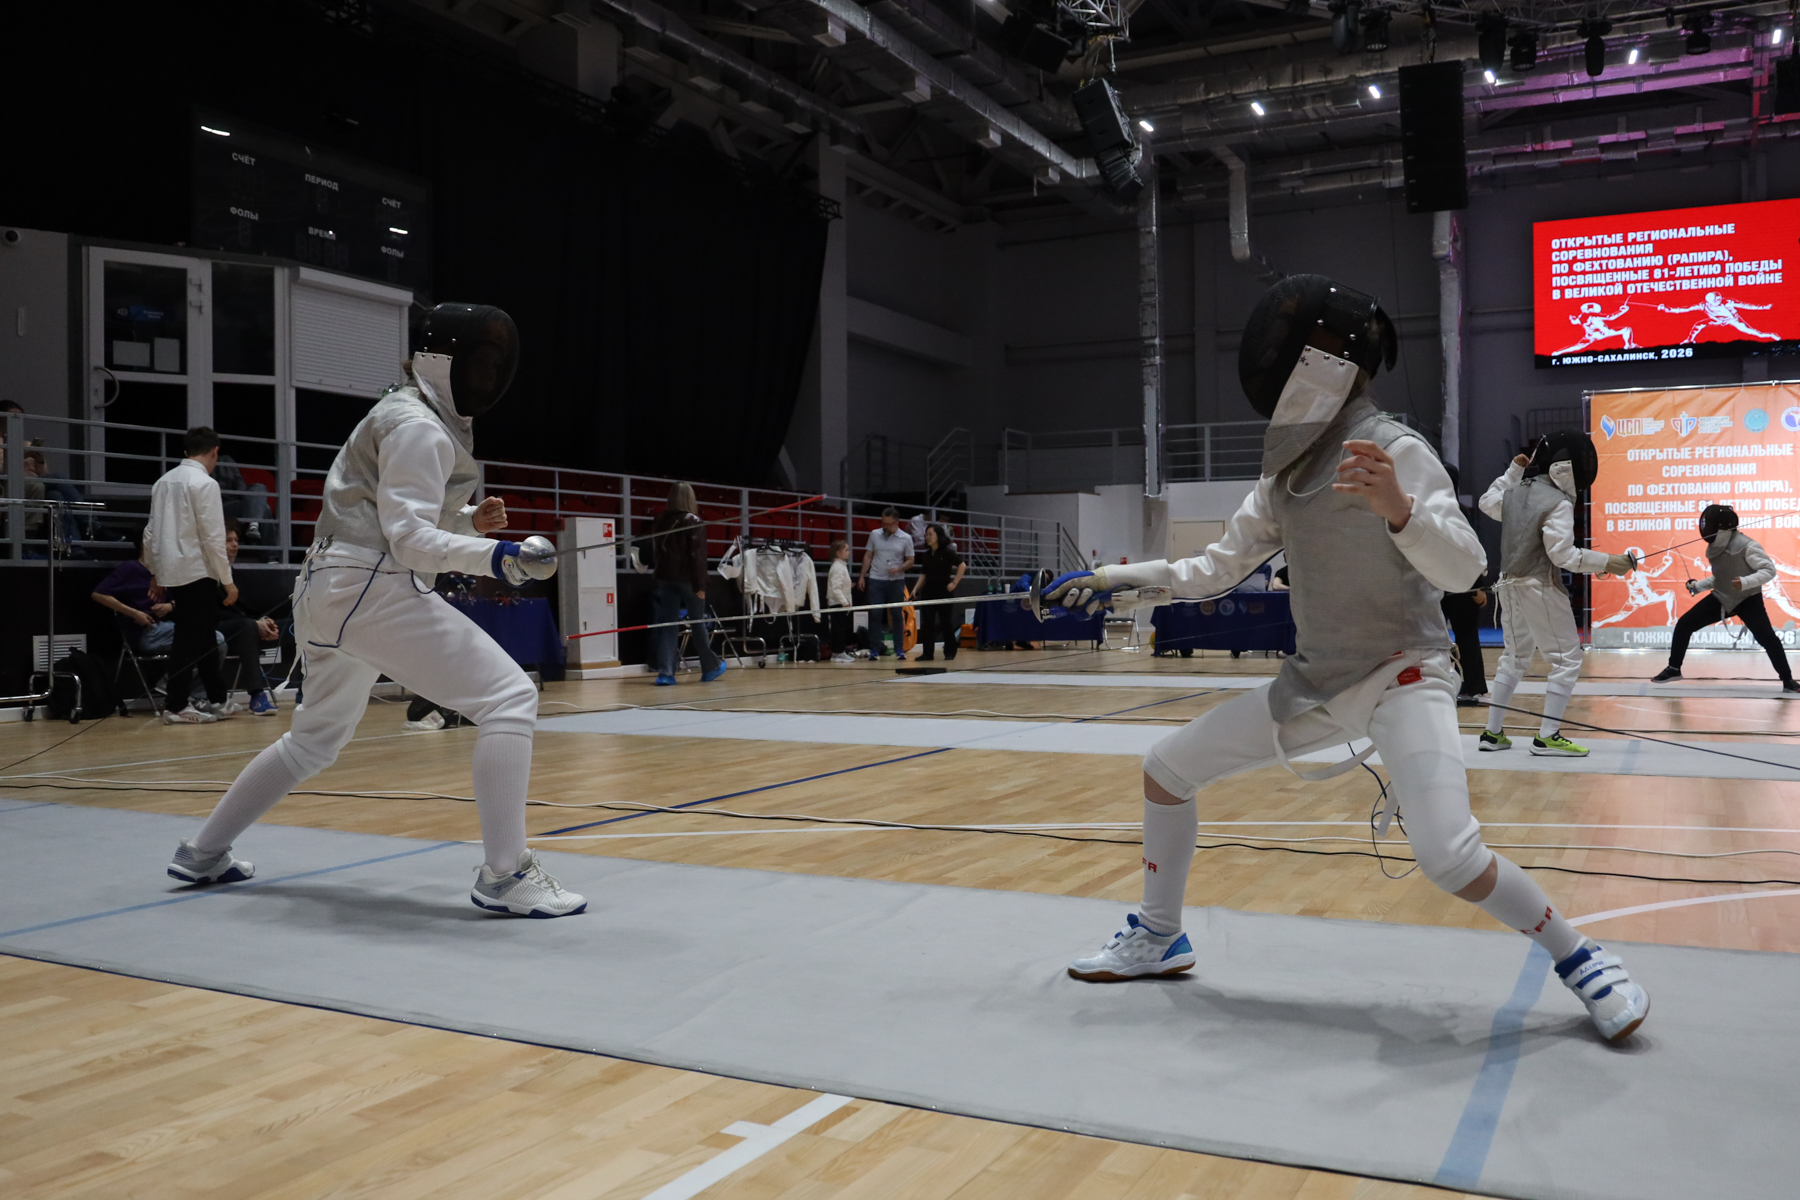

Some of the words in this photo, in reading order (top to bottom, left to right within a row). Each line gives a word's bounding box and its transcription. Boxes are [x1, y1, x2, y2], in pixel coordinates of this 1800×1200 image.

[231, 152, 256, 166] СЧЁТ
[304, 173, 339, 191] ПЕРИОД
[381, 197, 401, 209] СЧЁТ
[230, 206, 259, 221] ФОЛЫ
[308, 226, 336, 241] ВРЕМЯ
[1551, 233, 1623, 250] ОТКРЫТЫЕ
[1627, 223, 1736, 243] РЕГИОНАЛЬНЫЕ
[380, 245, 404, 258] ФОЛЫ
[1551, 243, 1654, 262] СОРЕВНОВАНИЯ
[1552, 263, 1569, 274] ПО
[1572, 255, 1664, 272] ФЕХТОВАНИЮ
[1667, 249, 1733, 267] (РАПИРА),
[1552, 271, 1650, 287] ПОСВЯЩЕННЫЕ
[1653, 264, 1721, 280] 81-ЛЕТИЮ
[1725, 259, 1783, 275] ПОБЕДЫ
[1552, 289, 1561, 300] В
[1565, 283, 1623, 299] ВЕЛИКОЙ
[1627, 274, 1734, 295] ОТЕЧЕСТВЕННОЙ
[1738, 272, 1783, 286] ВОЙНЕ
[1562, 351, 1659, 365] ЮЖНО-САХАЛИНСК,
[1661, 348, 1693, 359] 2026
[1617, 419, 1641, 436] ЦСП
[1627, 447, 1692, 461] ОТКРЫТЫЕ
[1695, 443, 1794, 459] РЕГИОНАЛЬНЫЕ
[1662, 463, 1757, 477] СОРЕВНОВАНИЯ
[1627, 484, 1643, 496] ПО
[1646, 481, 1731, 496] ФЕХТОВАНИЮ
[1734, 480, 1793, 494] (РАПИРА),
[1604, 500, 1695, 515] ПОСВЯЩЕННЫЕ
[1698, 498, 1761, 513] 8ЕТИЮ
[1764, 498, 1800, 511] ПОБЕ
[1606, 519, 1615, 532] В
[1617, 517, 1672, 532] ВЕЛИКОЙ
